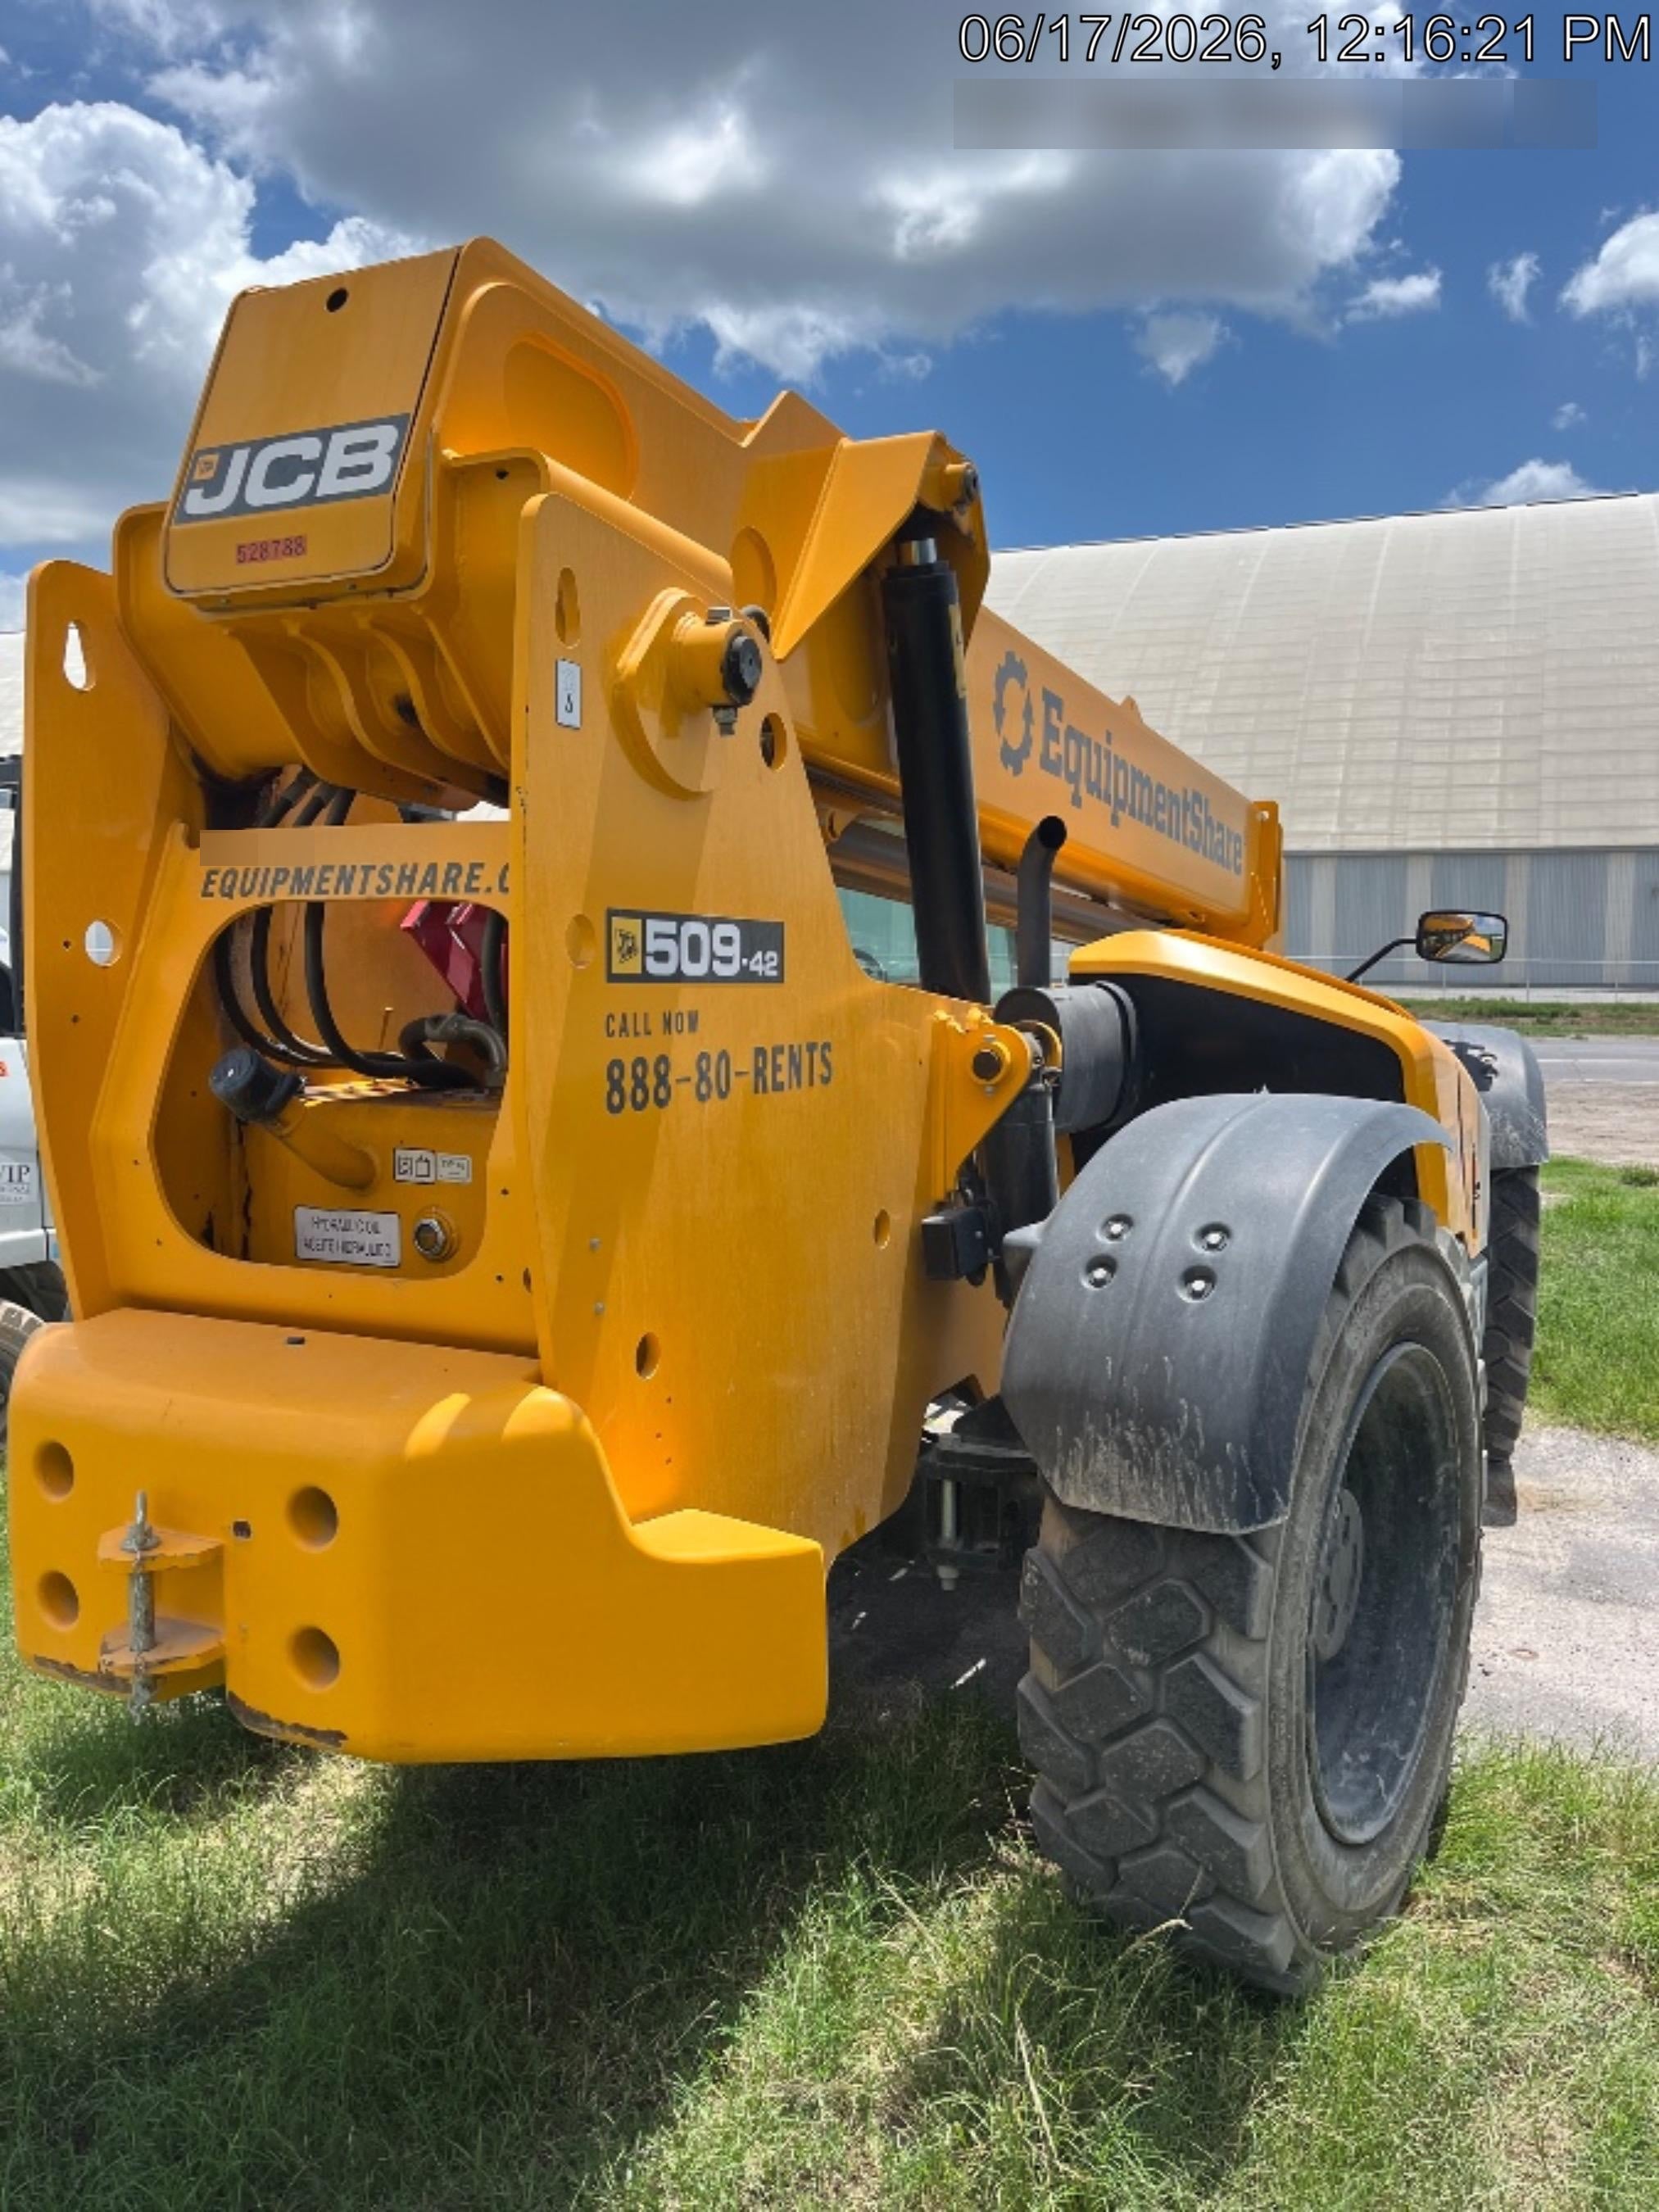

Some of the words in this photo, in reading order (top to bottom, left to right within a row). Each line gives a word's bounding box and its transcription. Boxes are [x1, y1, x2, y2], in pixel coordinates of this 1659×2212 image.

[184, 424, 399, 514] JCB
[1040, 687, 1243, 876] EquipmentShare
[605, 1013, 652, 1037] CALL
[662, 1010, 699, 1035] NOW
[606, 1041, 834, 1115] 888-80-RENTS
